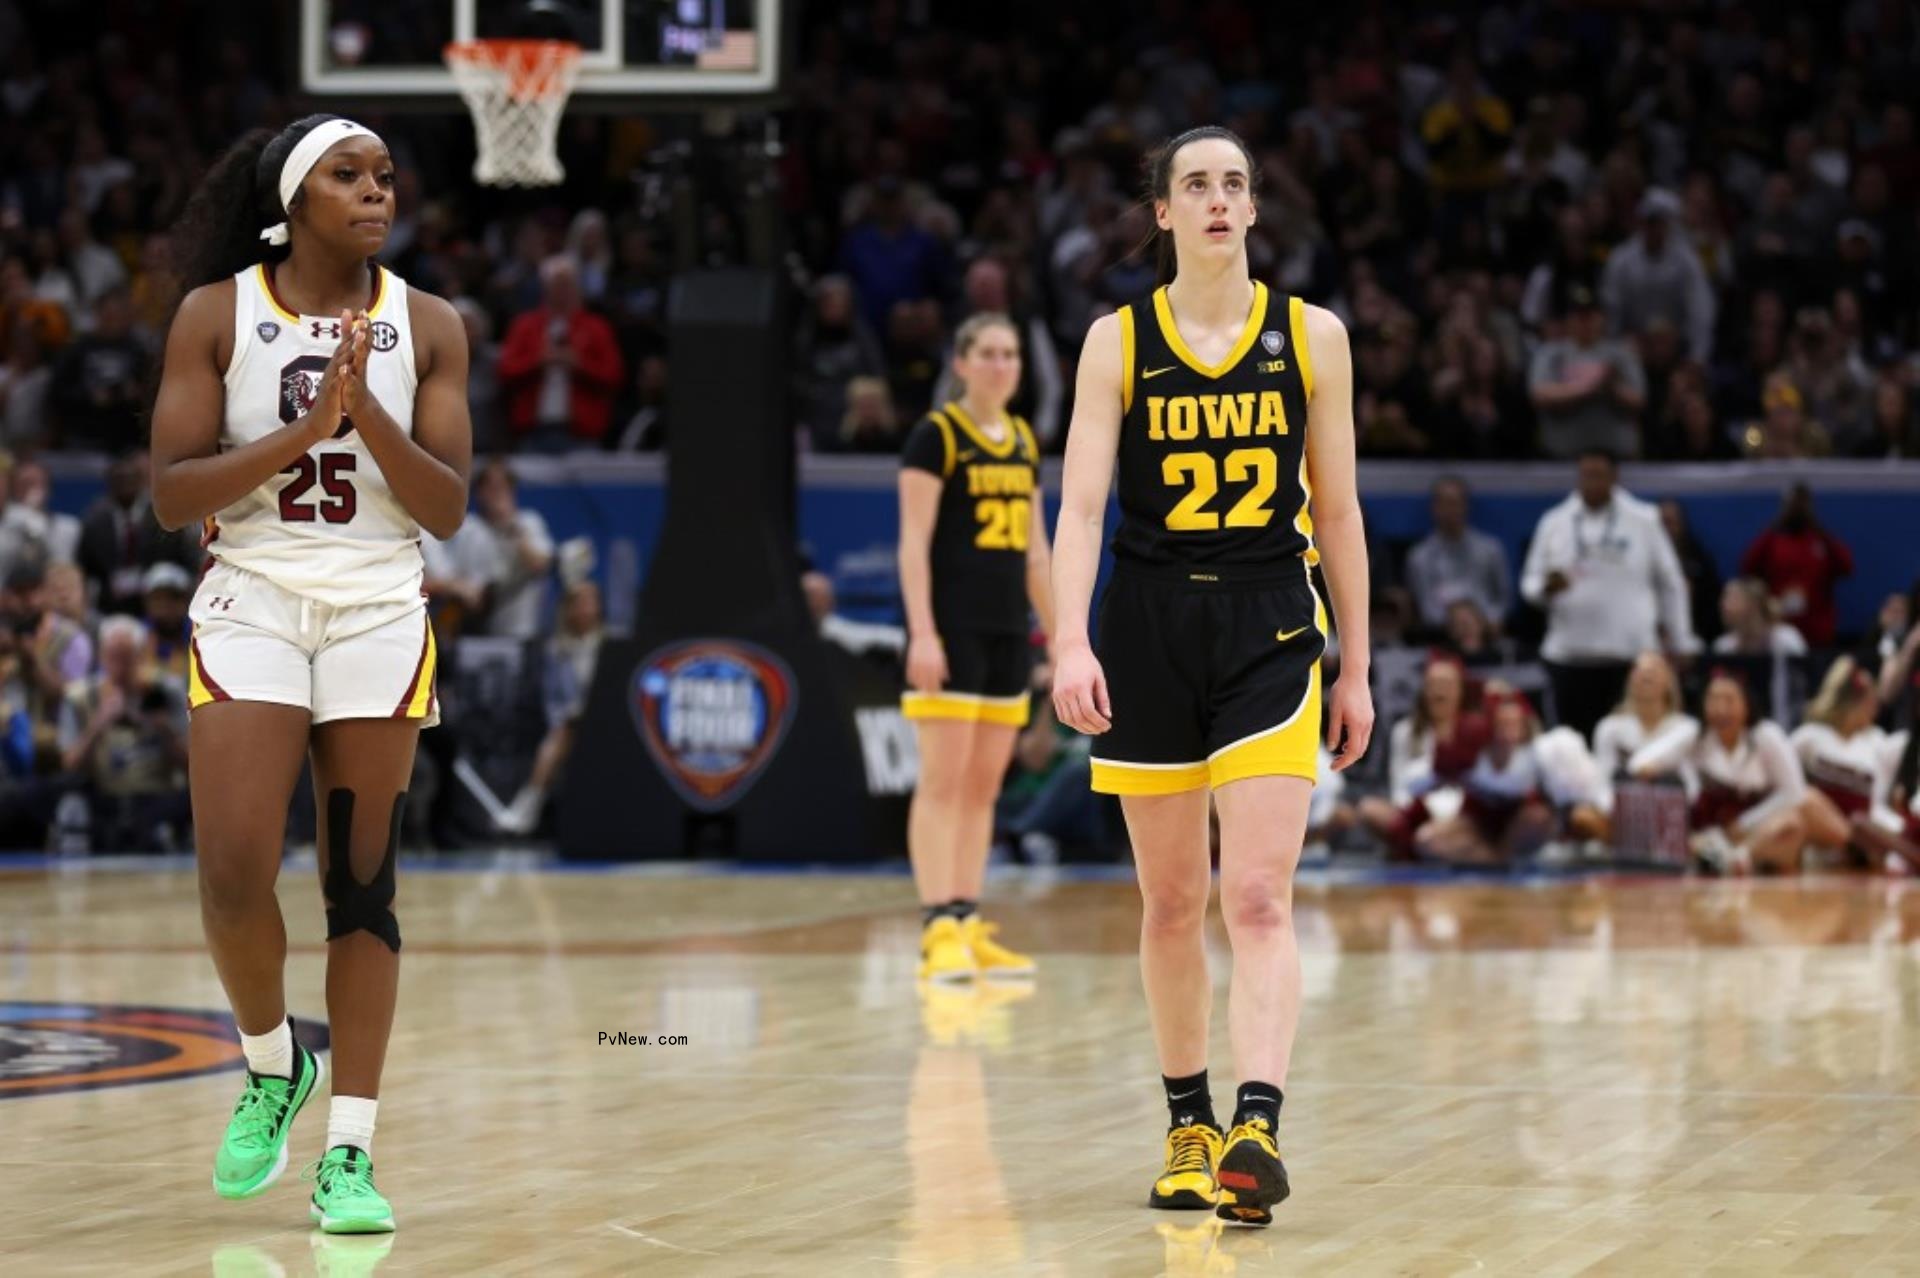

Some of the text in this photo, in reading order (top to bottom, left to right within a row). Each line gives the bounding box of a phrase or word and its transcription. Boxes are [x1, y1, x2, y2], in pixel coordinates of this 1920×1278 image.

[1147, 391, 1288, 440] IOWA
[278, 452, 356, 524] 25
[1162, 447, 1278, 530] 22
[975, 498, 1029, 549] 20
